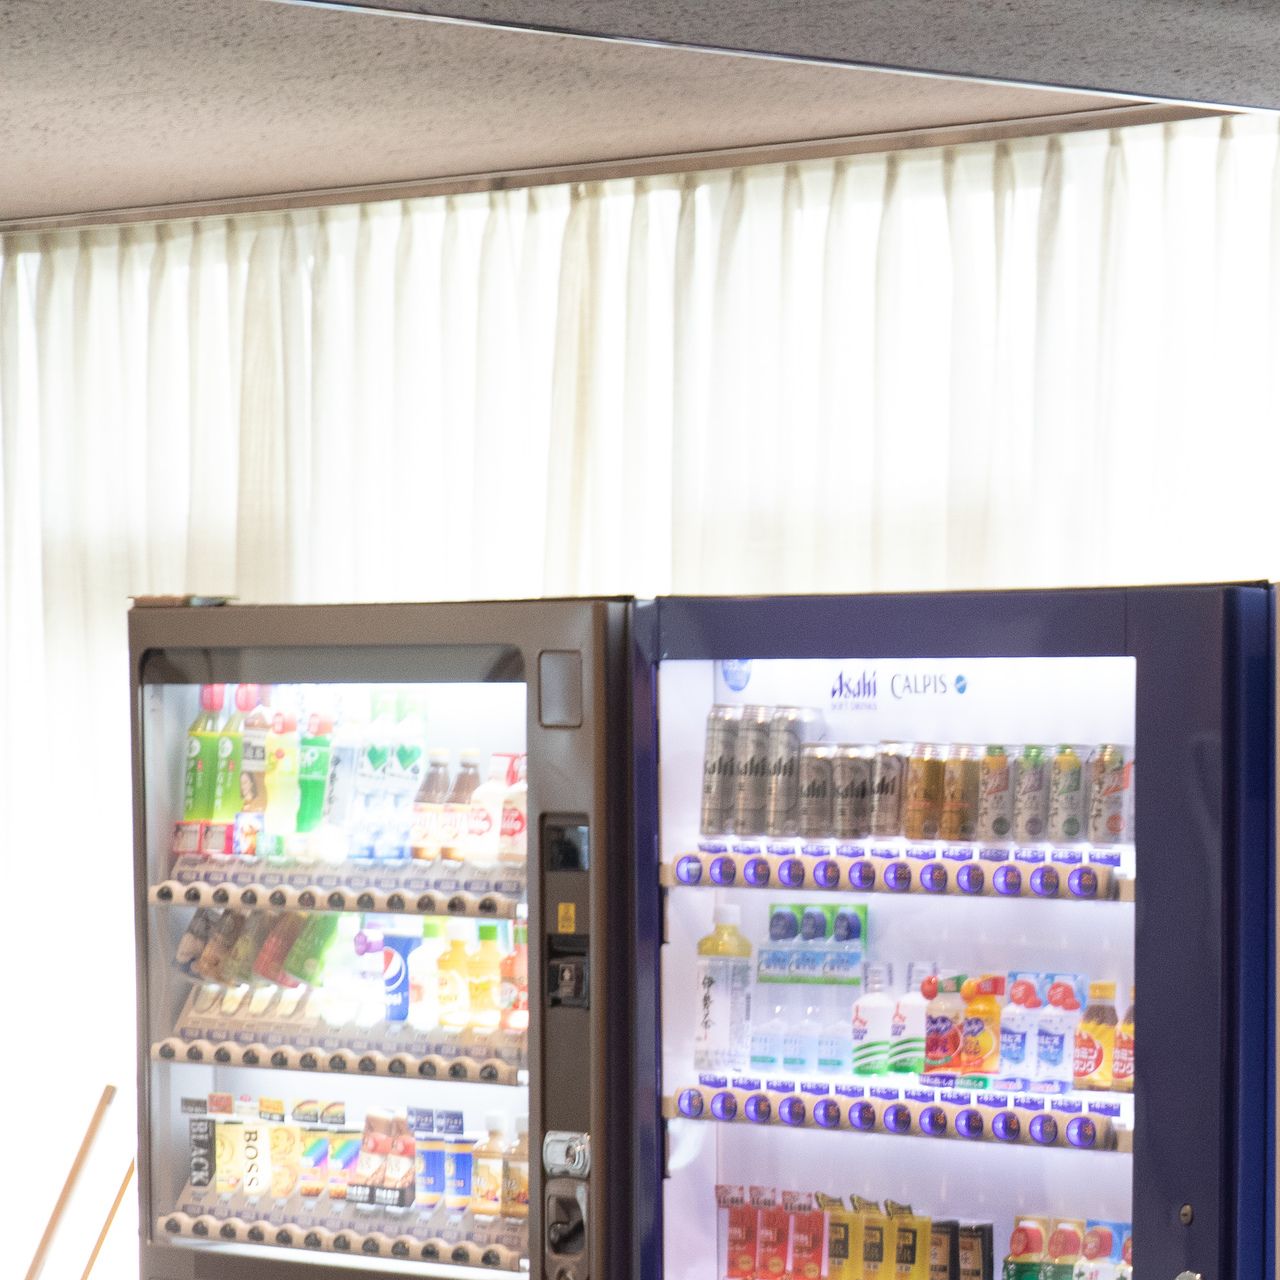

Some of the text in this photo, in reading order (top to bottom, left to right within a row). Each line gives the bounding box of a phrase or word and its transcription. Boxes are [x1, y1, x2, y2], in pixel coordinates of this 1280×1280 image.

[830, 669, 948, 700] Asahi CALPIS
[242, 1129, 260, 1190] BOSS
